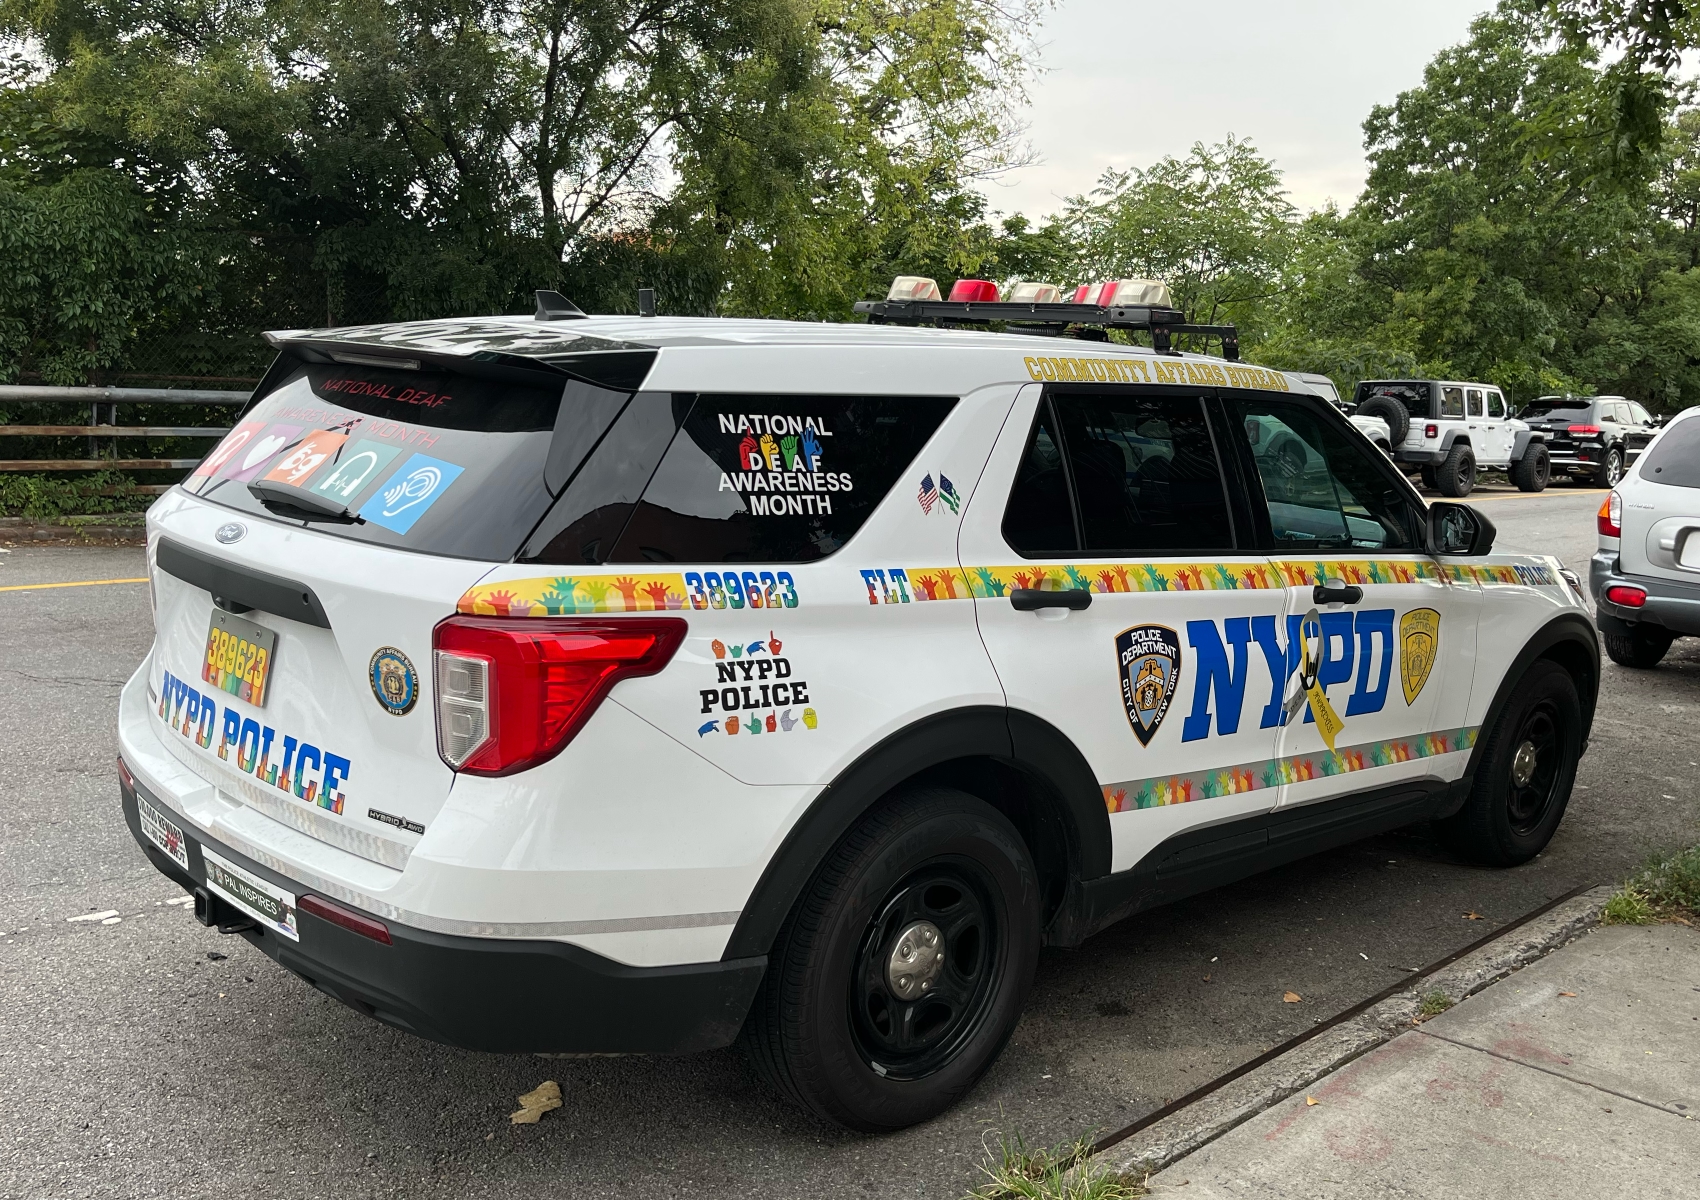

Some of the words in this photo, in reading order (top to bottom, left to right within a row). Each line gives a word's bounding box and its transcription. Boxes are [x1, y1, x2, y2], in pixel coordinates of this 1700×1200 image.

[1023, 356, 1151, 383] COMMUNITY
[1152, 361, 1228, 387] AFFAIRS
[1223, 365, 1290, 392] BUREAU
[319, 379, 395, 400] NATIONAL
[396, 388, 452, 409] DEAF
[273, 407, 364, 431] AWARENESS
[365, 420, 442, 449] MONTH
[718, 413, 833, 436] NATIONAL
[718, 472, 853, 492] AWARENESS
[750, 494, 833, 516] MONTH
[684, 571, 799, 610] 389623
[859, 568, 911, 605] FLT
[1402, 621, 1435, 638] DEPARTMENT
[1411, 611, 1432, 622] POLICE
[1131, 629, 1163, 645] POLICE
[207, 626, 267, 688] 389623
[1121, 641, 1177, 667] DEPARTMENT
[715, 658, 792, 684] NYPD
[1181, 608, 1395, 743] NYPD
[699, 681, 810, 714] POLICE
[1122, 678, 1133, 707] CITY
[1129, 708, 1139, 724] OF
[1154, 700, 1169, 725] NEW
[1166, 667, 1178, 697] YORK
[158, 669, 216, 750] NYPD
[217, 706, 351, 816] POLICE
[370, 811, 400, 826] HYBRID
[407, 823, 423, 833] AWD
[224, 874, 239, 893] PAL
[239, 883, 277, 916] INSPIRES
